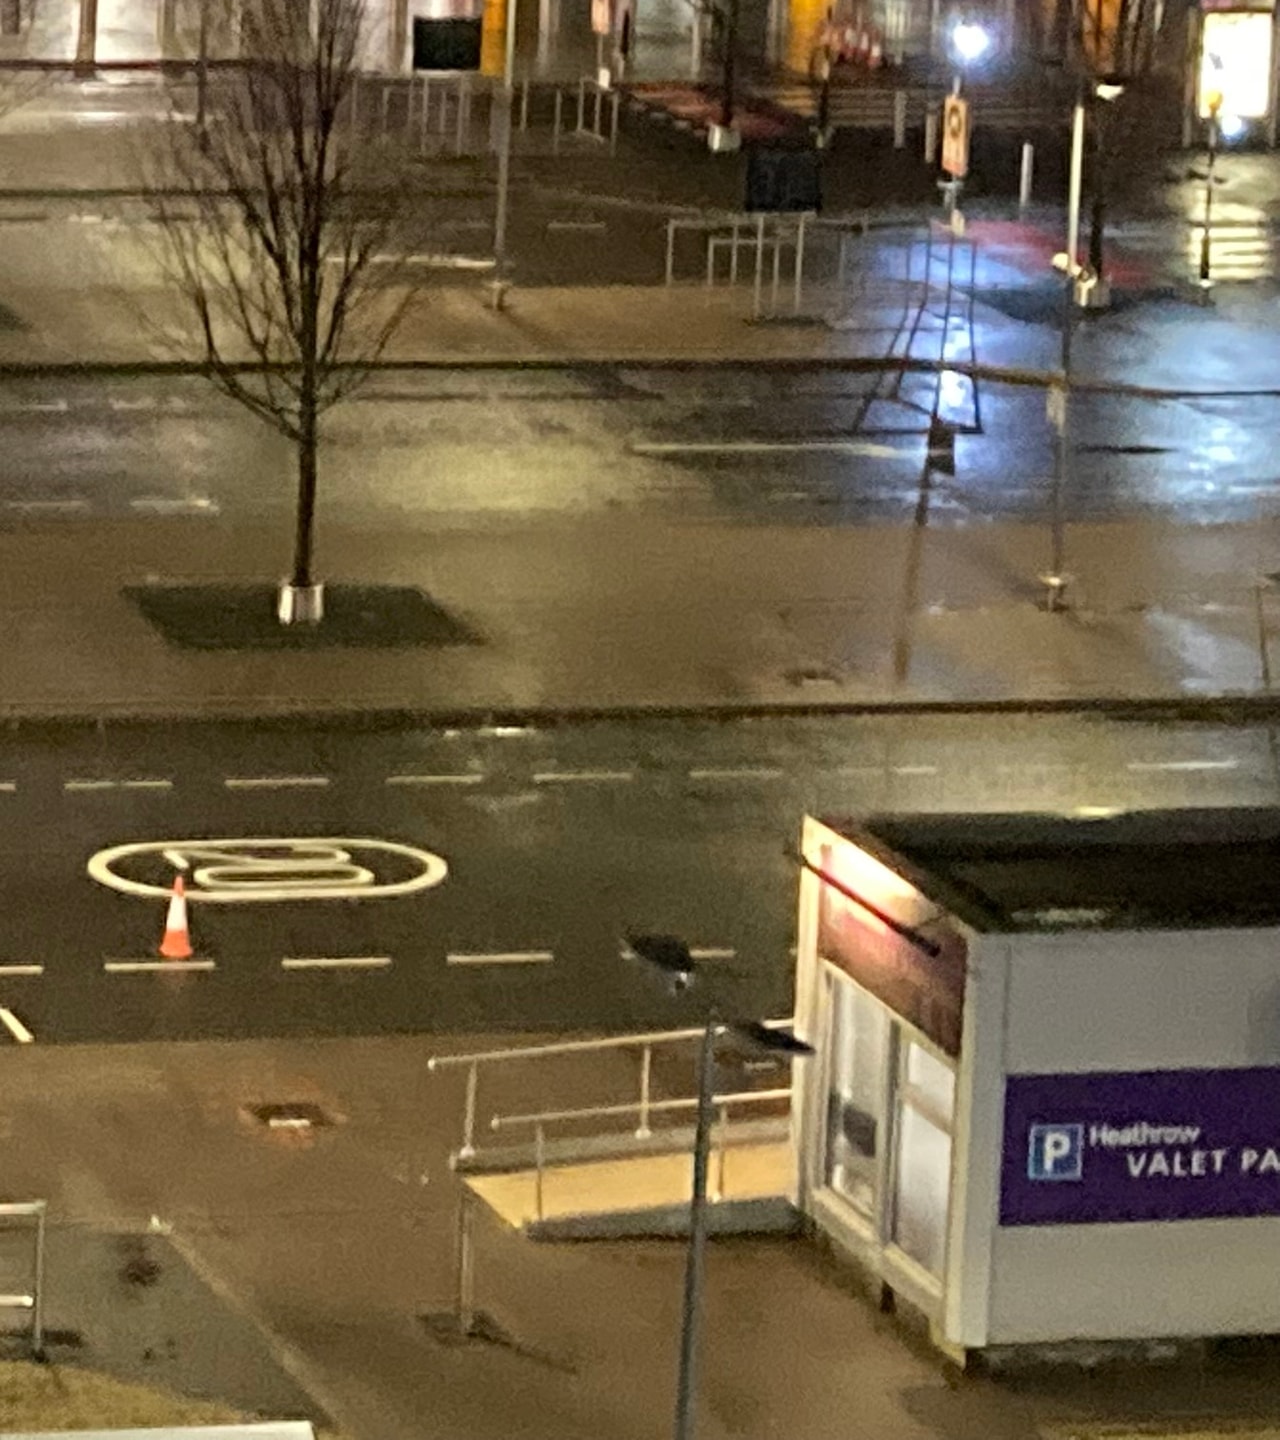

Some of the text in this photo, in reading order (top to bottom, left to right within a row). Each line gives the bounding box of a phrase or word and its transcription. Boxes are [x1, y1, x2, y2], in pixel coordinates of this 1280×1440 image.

[1090, 1122, 1200, 1148] Heathrow
[1043, 1131, 1071, 1174] P
[1127, 1148, 1229, 1178] VALET
